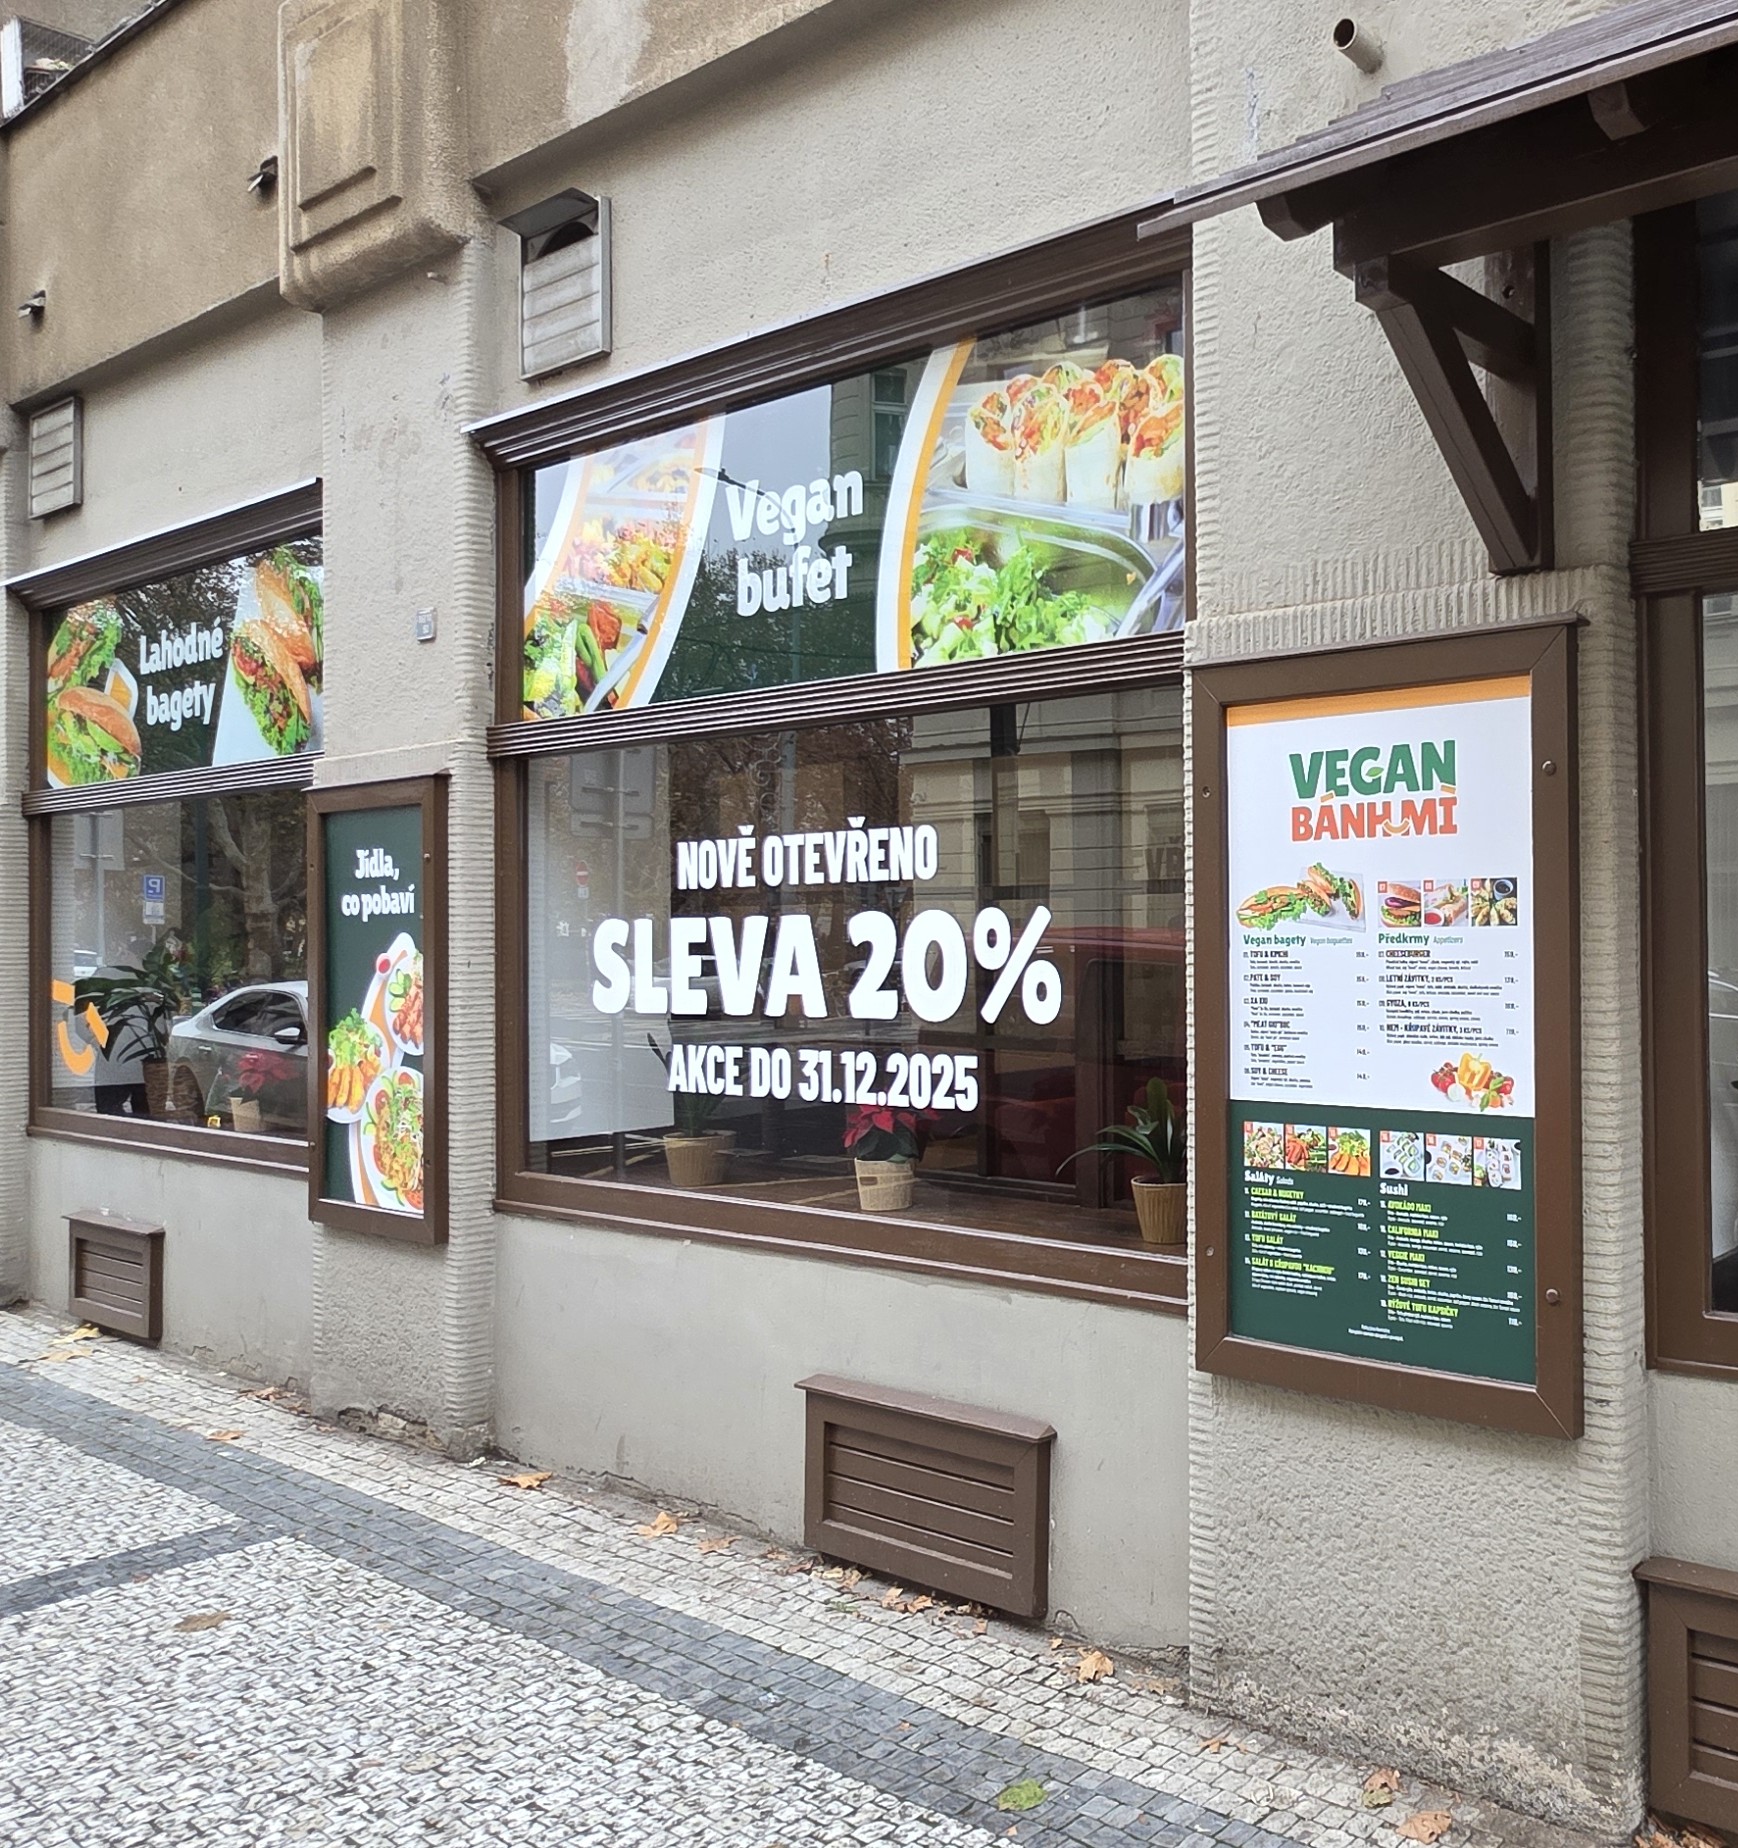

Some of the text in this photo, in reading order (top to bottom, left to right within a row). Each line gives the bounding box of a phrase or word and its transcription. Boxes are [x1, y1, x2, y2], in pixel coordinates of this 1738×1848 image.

[725, 470, 863, 546] Vegan
[737, 545, 852, 617] bufet
[139, 617, 224, 675] Lahodné
[146, 682, 216, 731] bagety
[1289, 739, 1456, 799] VEGAN
[1291, 792, 1392, 842] BÁNH
[355, 848, 400, 881] Jídla,
[677, 816, 938, 890] NOVĚ OTEVŘENO
[341, 883, 416, 923] co pobaví
[592, 904, 1063, 1026] SLEVA 20%
[1243, 934, 1272, 947] Vegan
[1274, 934, 1306, 947] bagety
[1378, 932, 1430, 946] Předkrmy
[667, 1044, 979, 1112] AKCE DO 31.12.2025
[1380, 1182, 1408, 1196] Sushi
